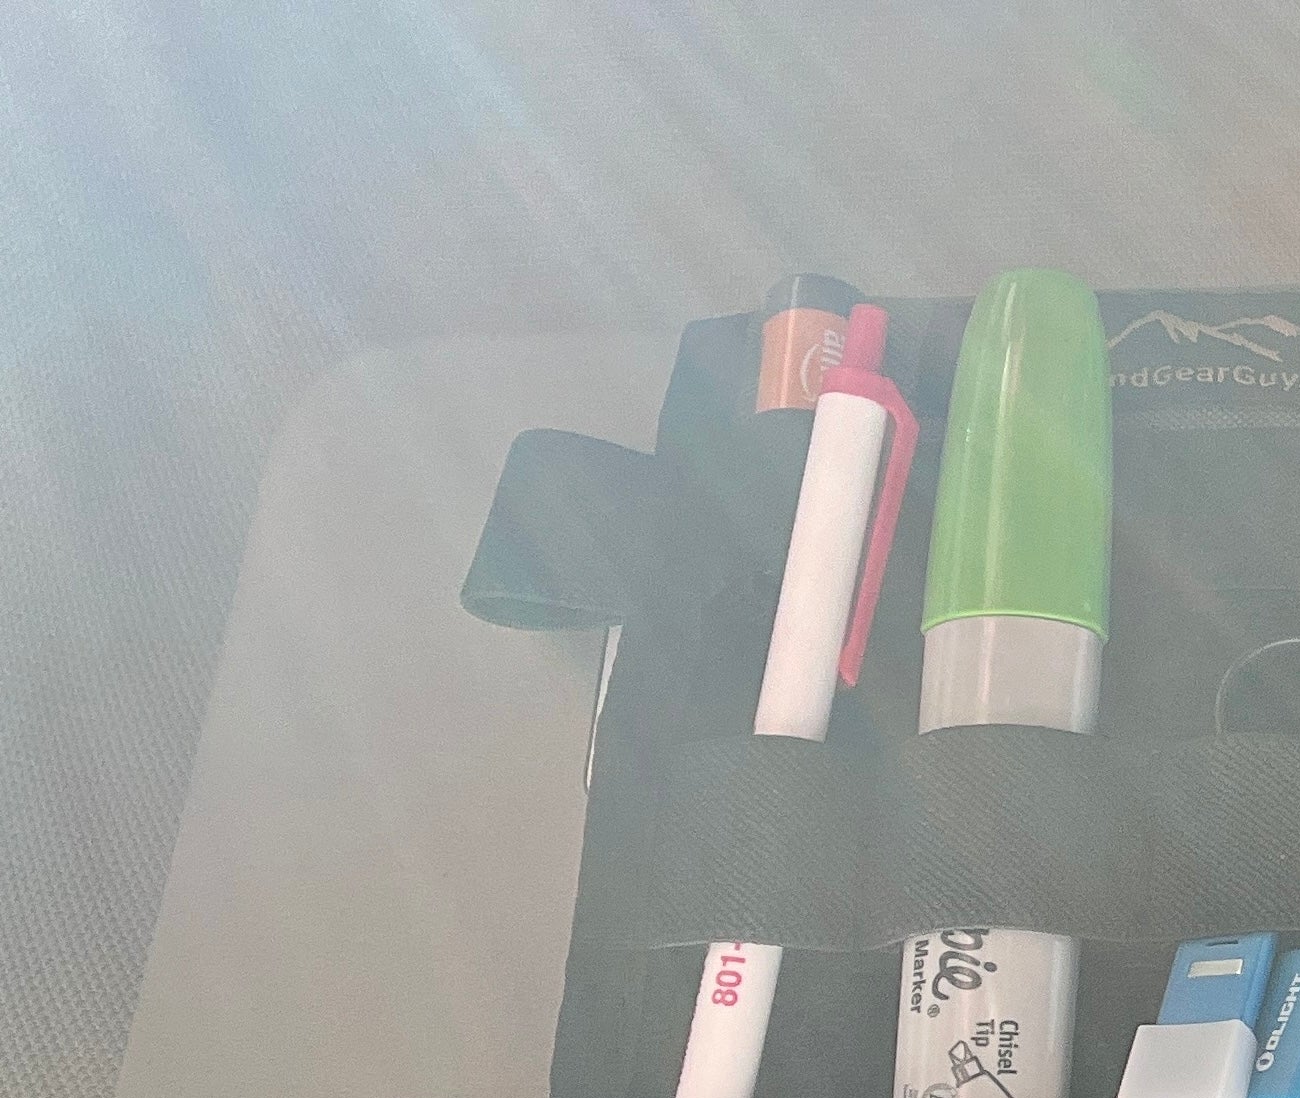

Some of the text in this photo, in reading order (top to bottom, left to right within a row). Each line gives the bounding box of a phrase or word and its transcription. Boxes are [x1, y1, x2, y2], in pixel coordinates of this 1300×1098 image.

[910, 939, 930, 1014] Marker
[970, 1018, 995, 1048] Tip
[996, 1019, 1020, 1076] Chisel
